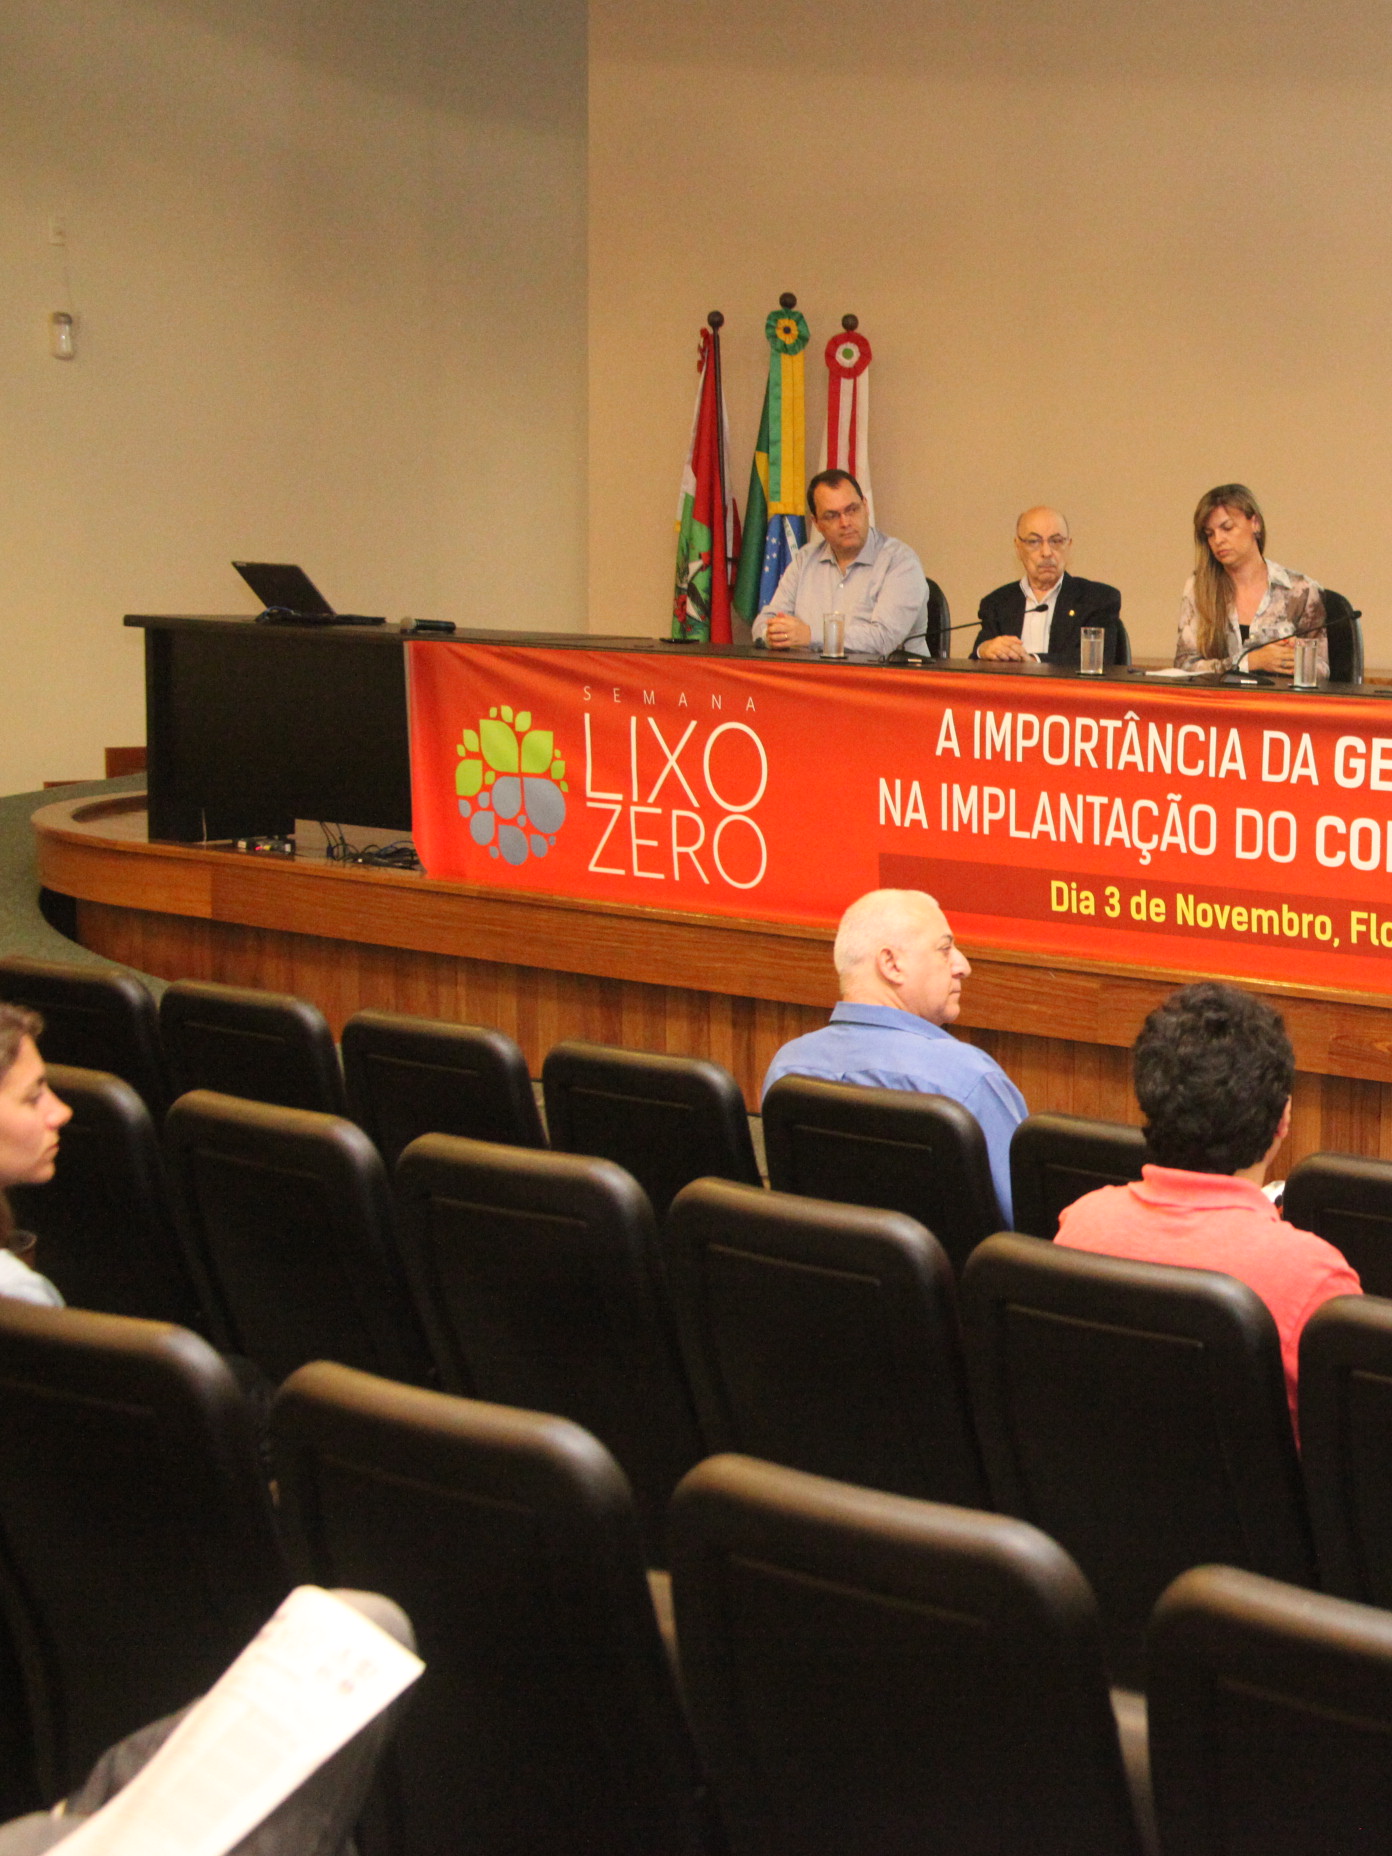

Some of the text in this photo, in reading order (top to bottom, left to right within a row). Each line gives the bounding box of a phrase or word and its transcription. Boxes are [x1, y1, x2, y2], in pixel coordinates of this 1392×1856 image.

[583, 686, 756, 712] SEMANA
[584, 712, 768, 813] LIXO
[935, 708, 960, 757] A
[973, 709, 1247, 780] IMPORTÂNCIA
[1261, 730, 1319, 786] DA
[586, 801, 767, 889] ZERO
[879, 777, 928, 829] NA
[941, 782, 1217, 865] IMPLANTAÇÃO
[1235, 808, 1297, 863] DO
[1050, 880, 1095, 915] Dia
[1104, 886, 1121, 917] 3
[1130, 890, 1166, 922] de
[1175, 893, 1340, 947] Novembro,
